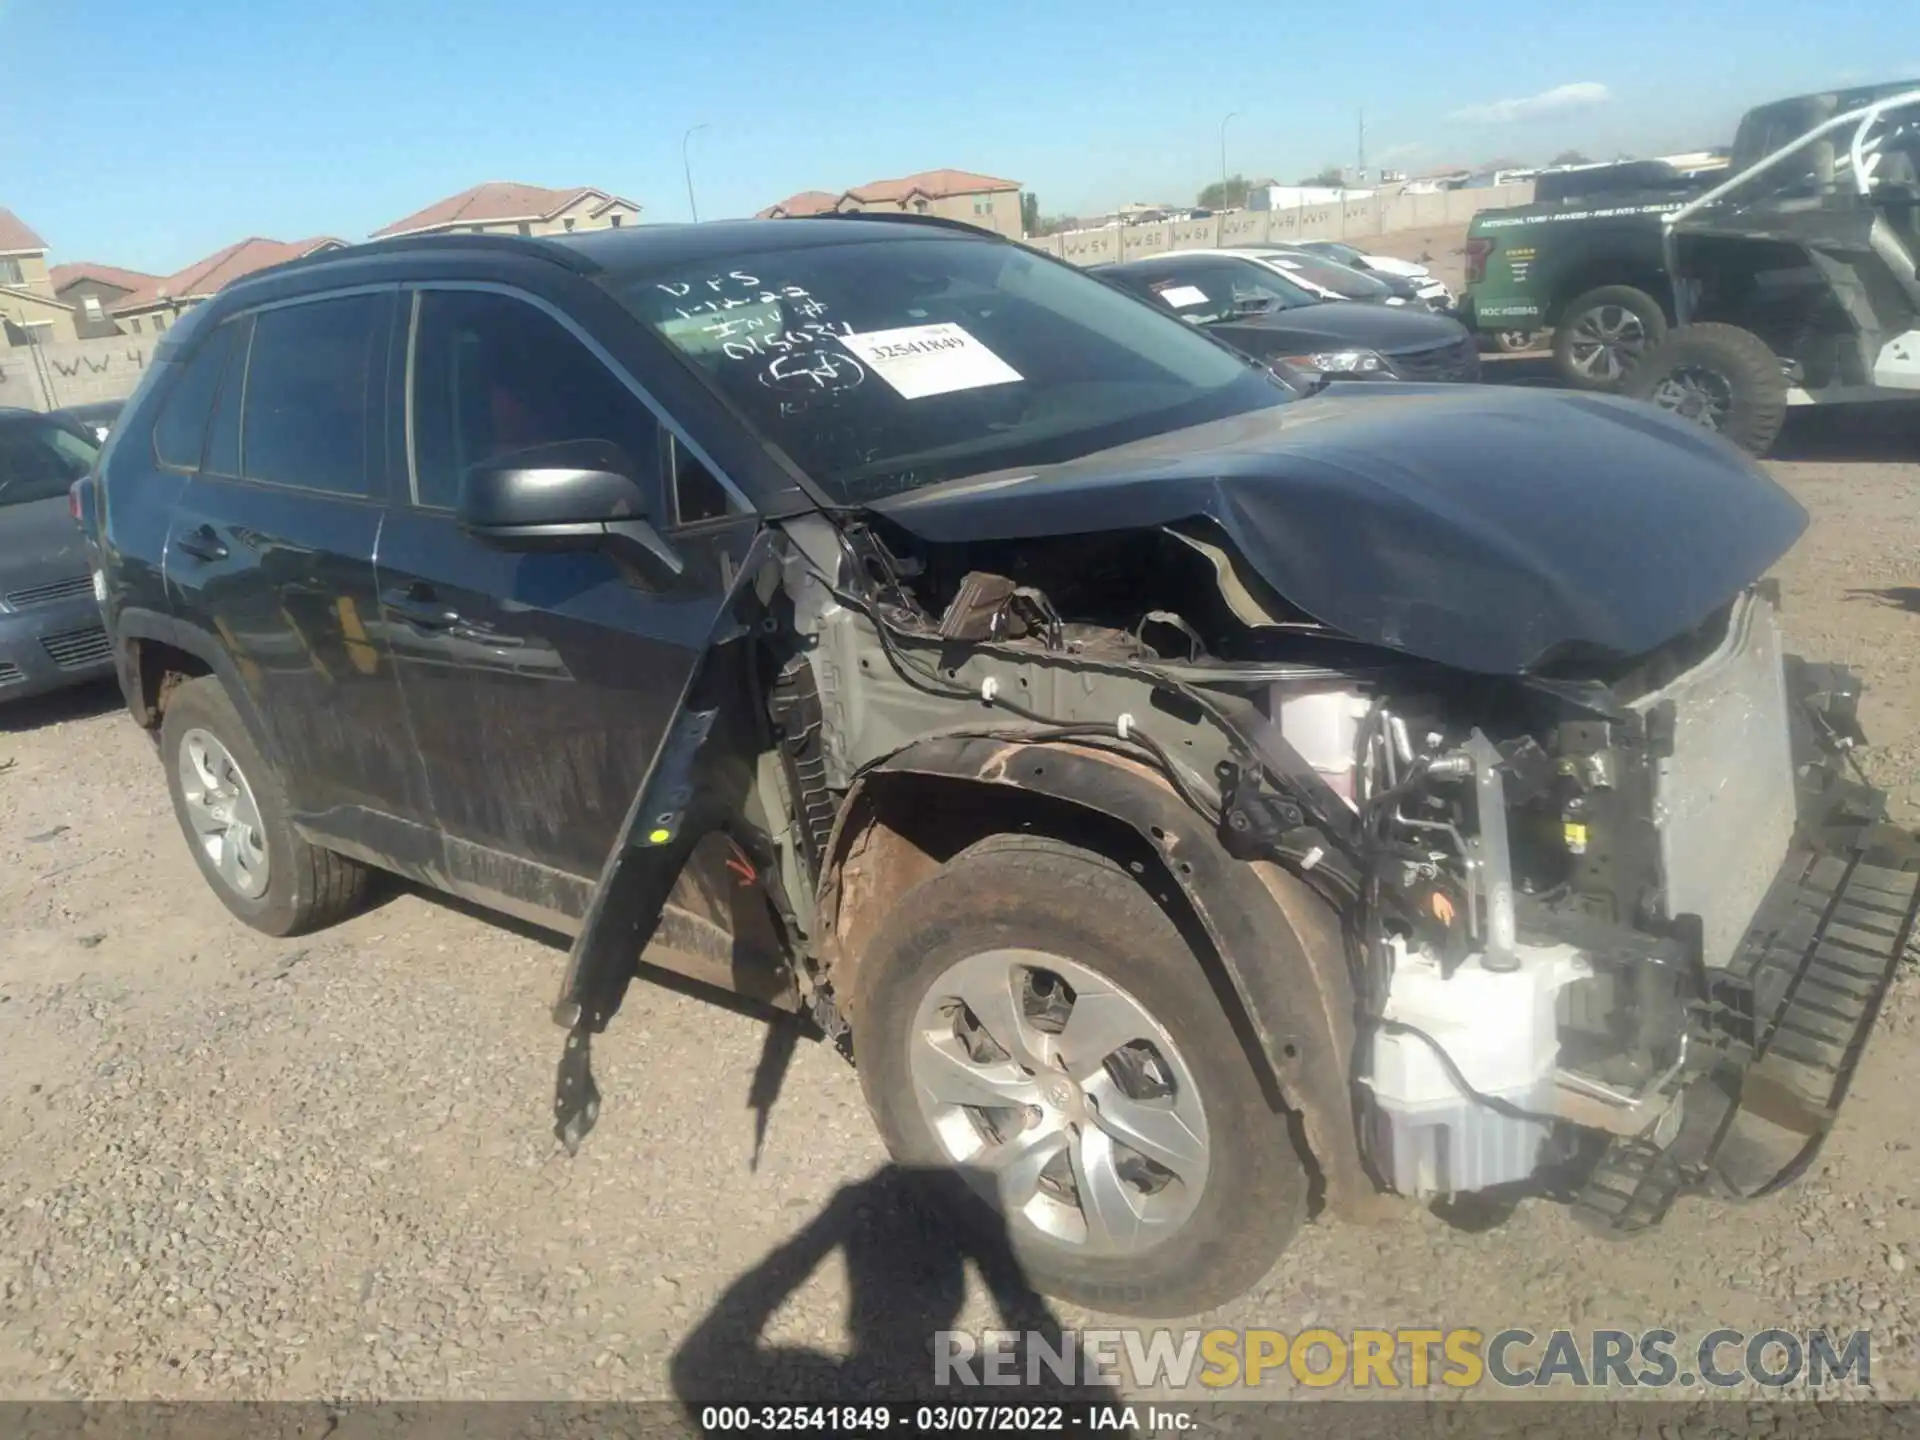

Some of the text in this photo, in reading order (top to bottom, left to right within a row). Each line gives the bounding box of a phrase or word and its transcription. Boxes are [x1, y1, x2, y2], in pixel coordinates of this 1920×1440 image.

[1065, 243, 1088, 256] WW
[868, 335, 966, 361] 32541849
[52, 353, 109, 376] WW
